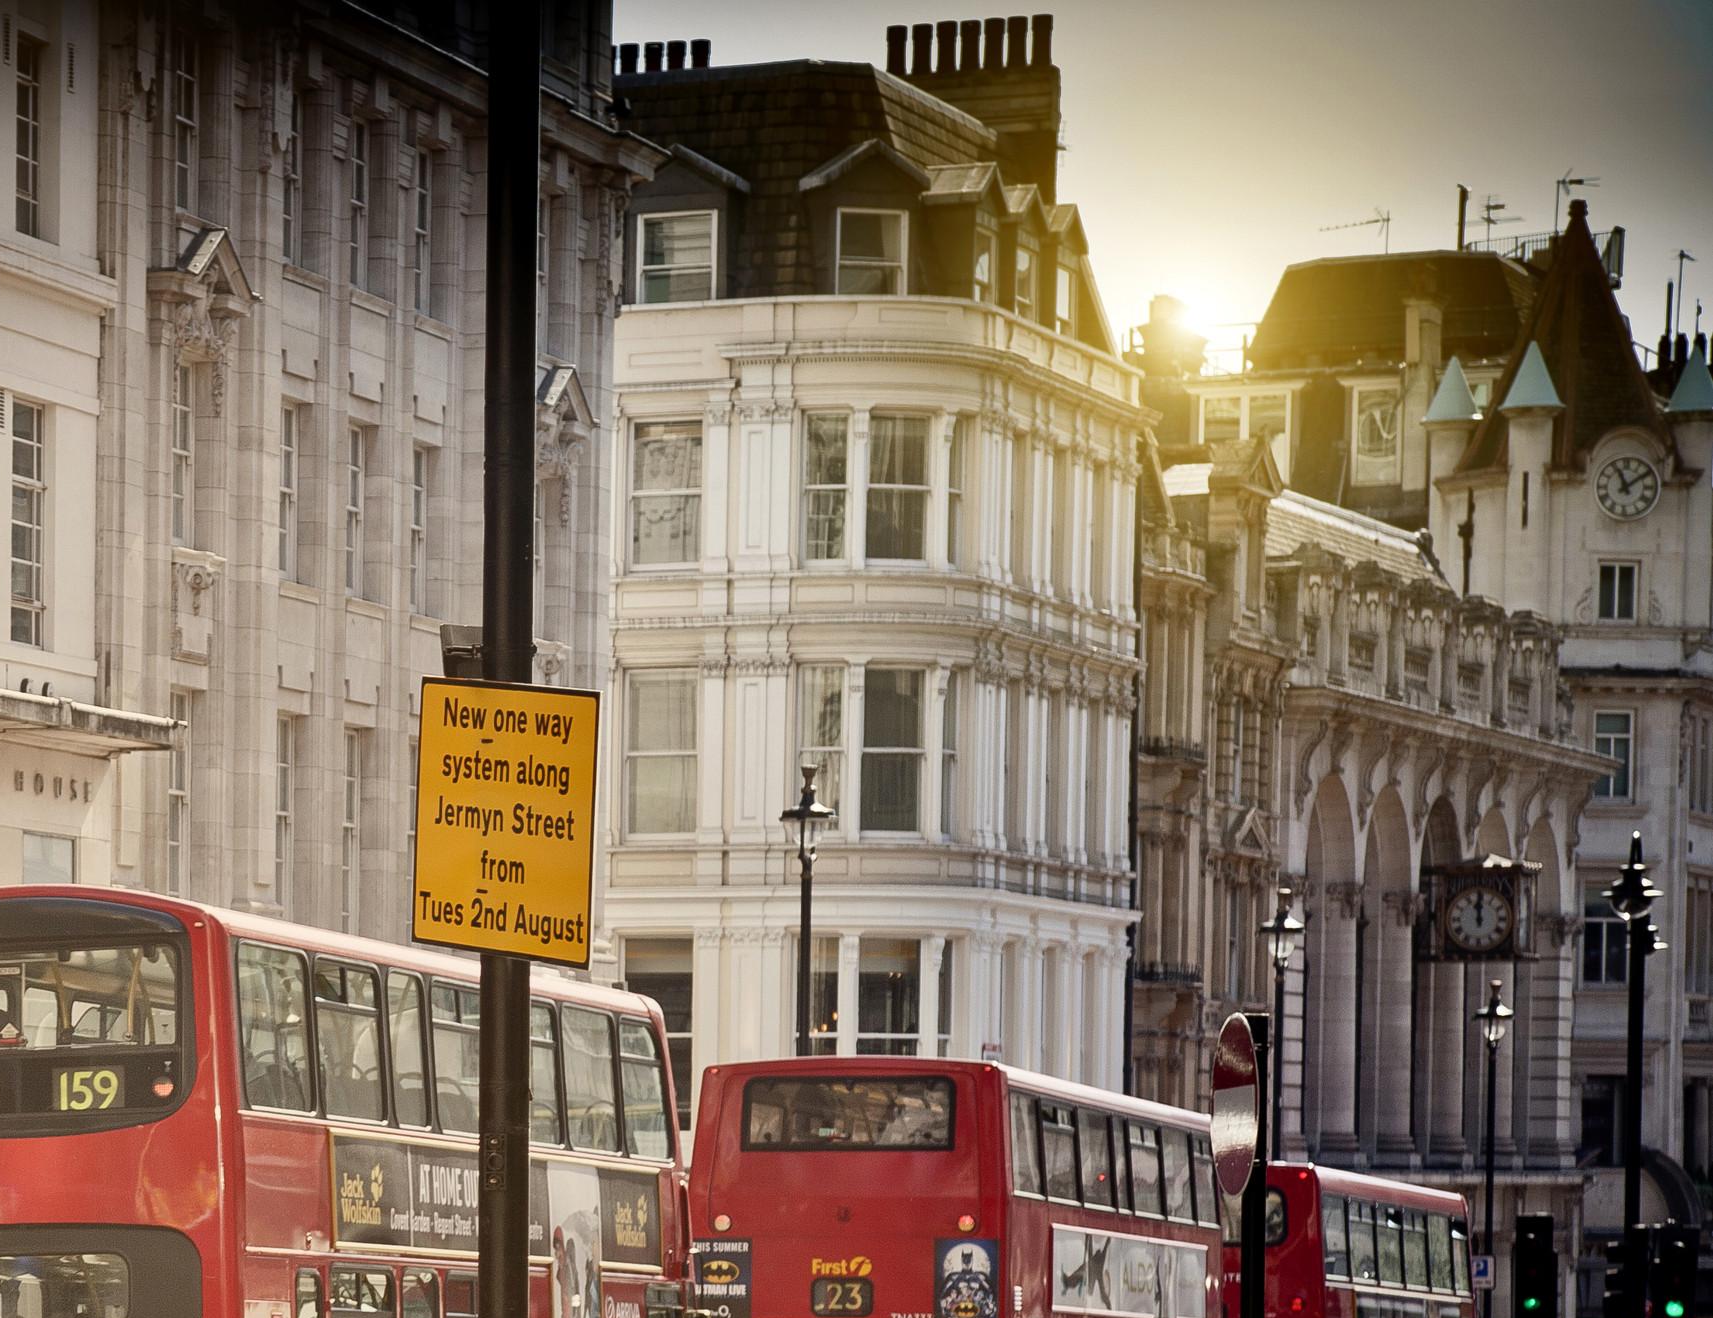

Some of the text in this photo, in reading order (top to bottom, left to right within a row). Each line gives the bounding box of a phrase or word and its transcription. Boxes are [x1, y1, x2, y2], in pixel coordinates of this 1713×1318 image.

[443, 696, 573, 744] New one way
[14, 769, 93, 803] HOUSE
[442, 750, 570, 795] system along
[435, 795, 574, 841] Jermyn Street
[481, 850, 525, 884] from
[419, 891, 584, 944] Tues 2nd August
[59, 1070, 118, 1111] 159
[340, 1172, 364, 1199] Jack
[419, 1164, 431, 1203] AT
[432, 1166, 463, 1206] HOME
[340, 1198, 381, 1225] Wolfskin
[615, 1202, 633, 1224] Jack
[615, 1222, 647, 1248] Wolfskin
[714, 1242, 748, 1252] SUMMER
[812, 1258, 848, 1275] First
[1122, 1261, 1154, 1294] ALDO
[729, 1284, 747, 1296] LIVE
[826, 1282, 863, 1310] 23
